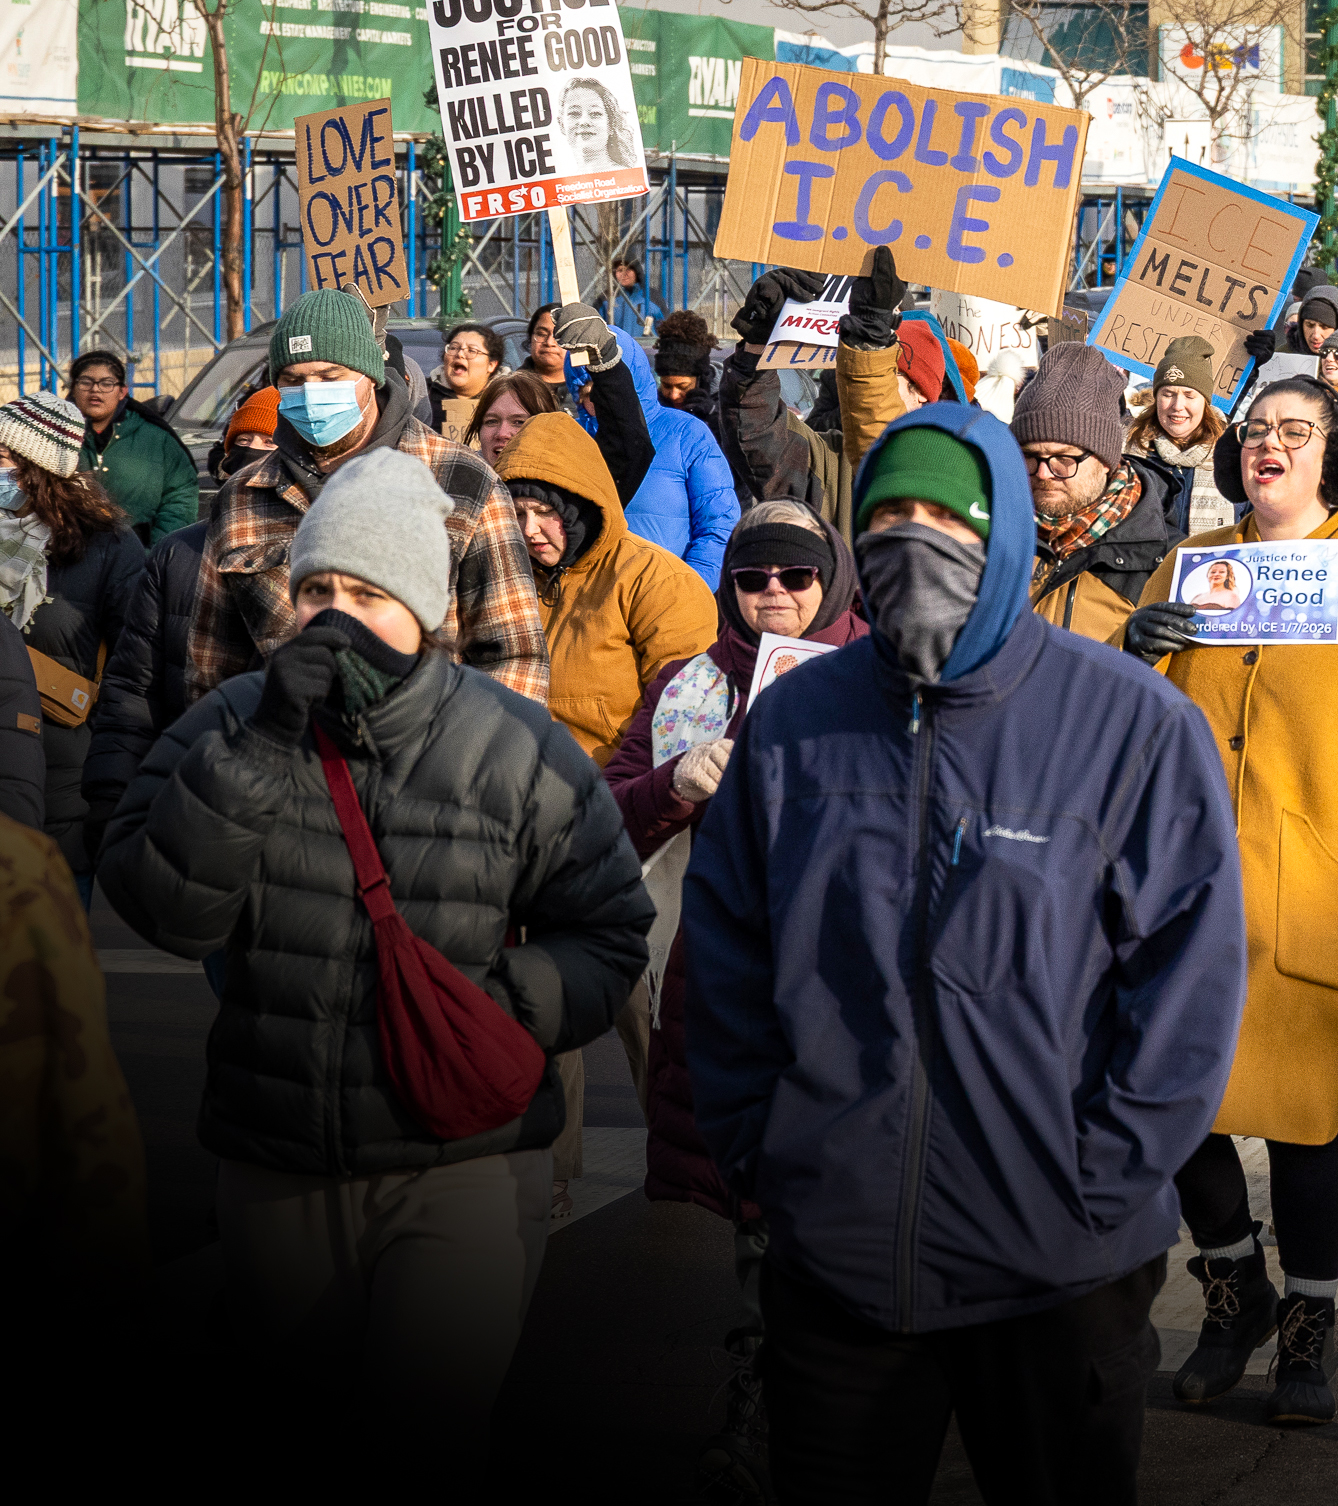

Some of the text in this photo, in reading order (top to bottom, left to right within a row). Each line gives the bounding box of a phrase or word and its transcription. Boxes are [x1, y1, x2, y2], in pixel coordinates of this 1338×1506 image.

[497, 13, 562, 37] FOR
[440, 26, 621, 88] RENEE GOOD
[260, 70, 392, 99] RYANCOMPANIES.COM
[688, 56, 742, 108] RYAN
[447, 87, 552, 141] KILLED
[739, 76, 1079, 190] ABOLISH
[306, 108, 391, 185] LOVE
[456, 134, 556, 188] BY ICE
[467, 186, 546, 217] FRSO
[555, 177, 615, 193] Freedom Road
[557, 184, 644, 203] Socialist Organization
[307, 175, 395, 247] OVER
[773, 160, 1014, 268] I.C.E.
[312, 237, 401, 295] FEAR
[1139, 247, 1269, 321] MELTS
[780, 316, 840, 335] MIRA
[957, 299, 981, 318] the
[1151, 299, 1222, 342] UNDER
[937, 311, 1031, 355] MADNESS
[1104, 314, 1244, 396] RESICE
[1245, 553, 1308, 563] Justice for
[1257, 566, 1328, 582] Renee
[1263, 588, 1324, 606] Good
[1196, 621, 1332, 635] rdered by ICE 1/7/2026
